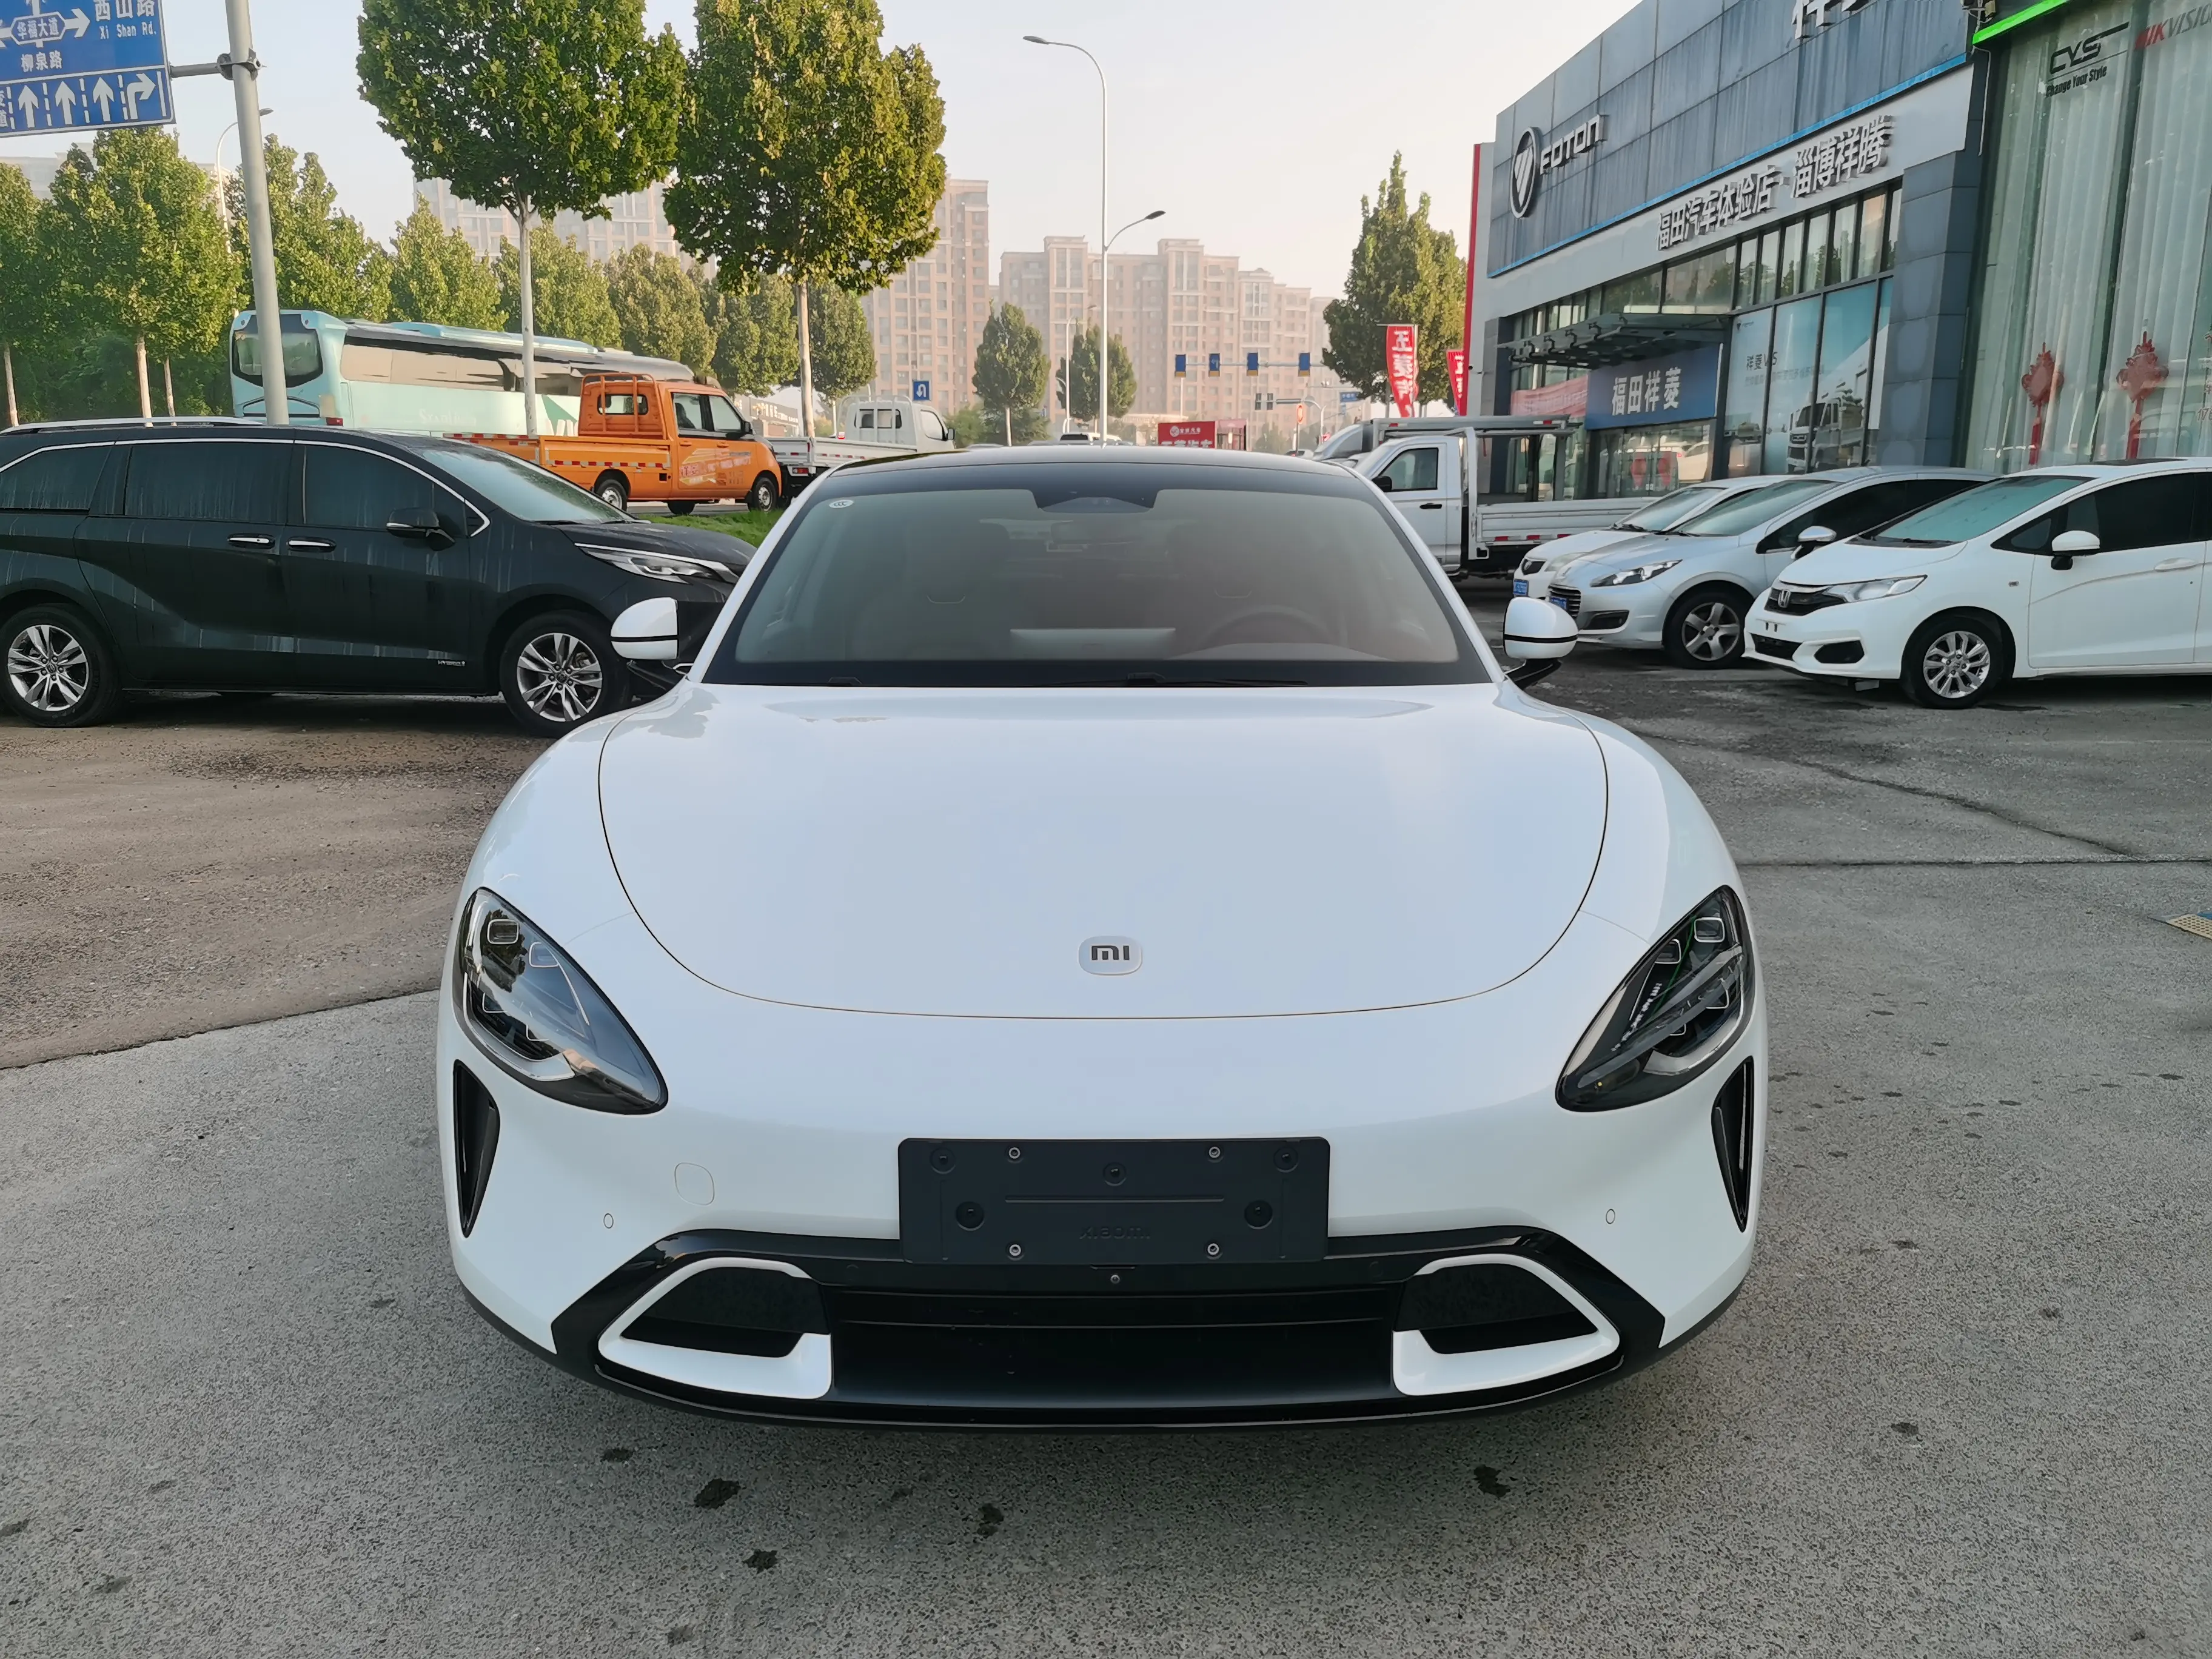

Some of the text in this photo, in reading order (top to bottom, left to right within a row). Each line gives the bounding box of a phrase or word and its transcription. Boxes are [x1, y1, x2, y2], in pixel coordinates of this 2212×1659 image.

[93, 0, 156, 22] 西山路
[16, 18, 59, 41] 华福大道
[99, 21, 157, 39] Xi Shan Rd.
[2134, 2, 2212, 50] HIKVISIO
[21, 50, 63, 73] 柳泉路
[2073, 74, 2089, 89] Your
[2089, 65, 2108, 83] Style
[1540, 114, 1601, 175] FOTON
[1612, 366, 1681, 416] 福田祥菱
